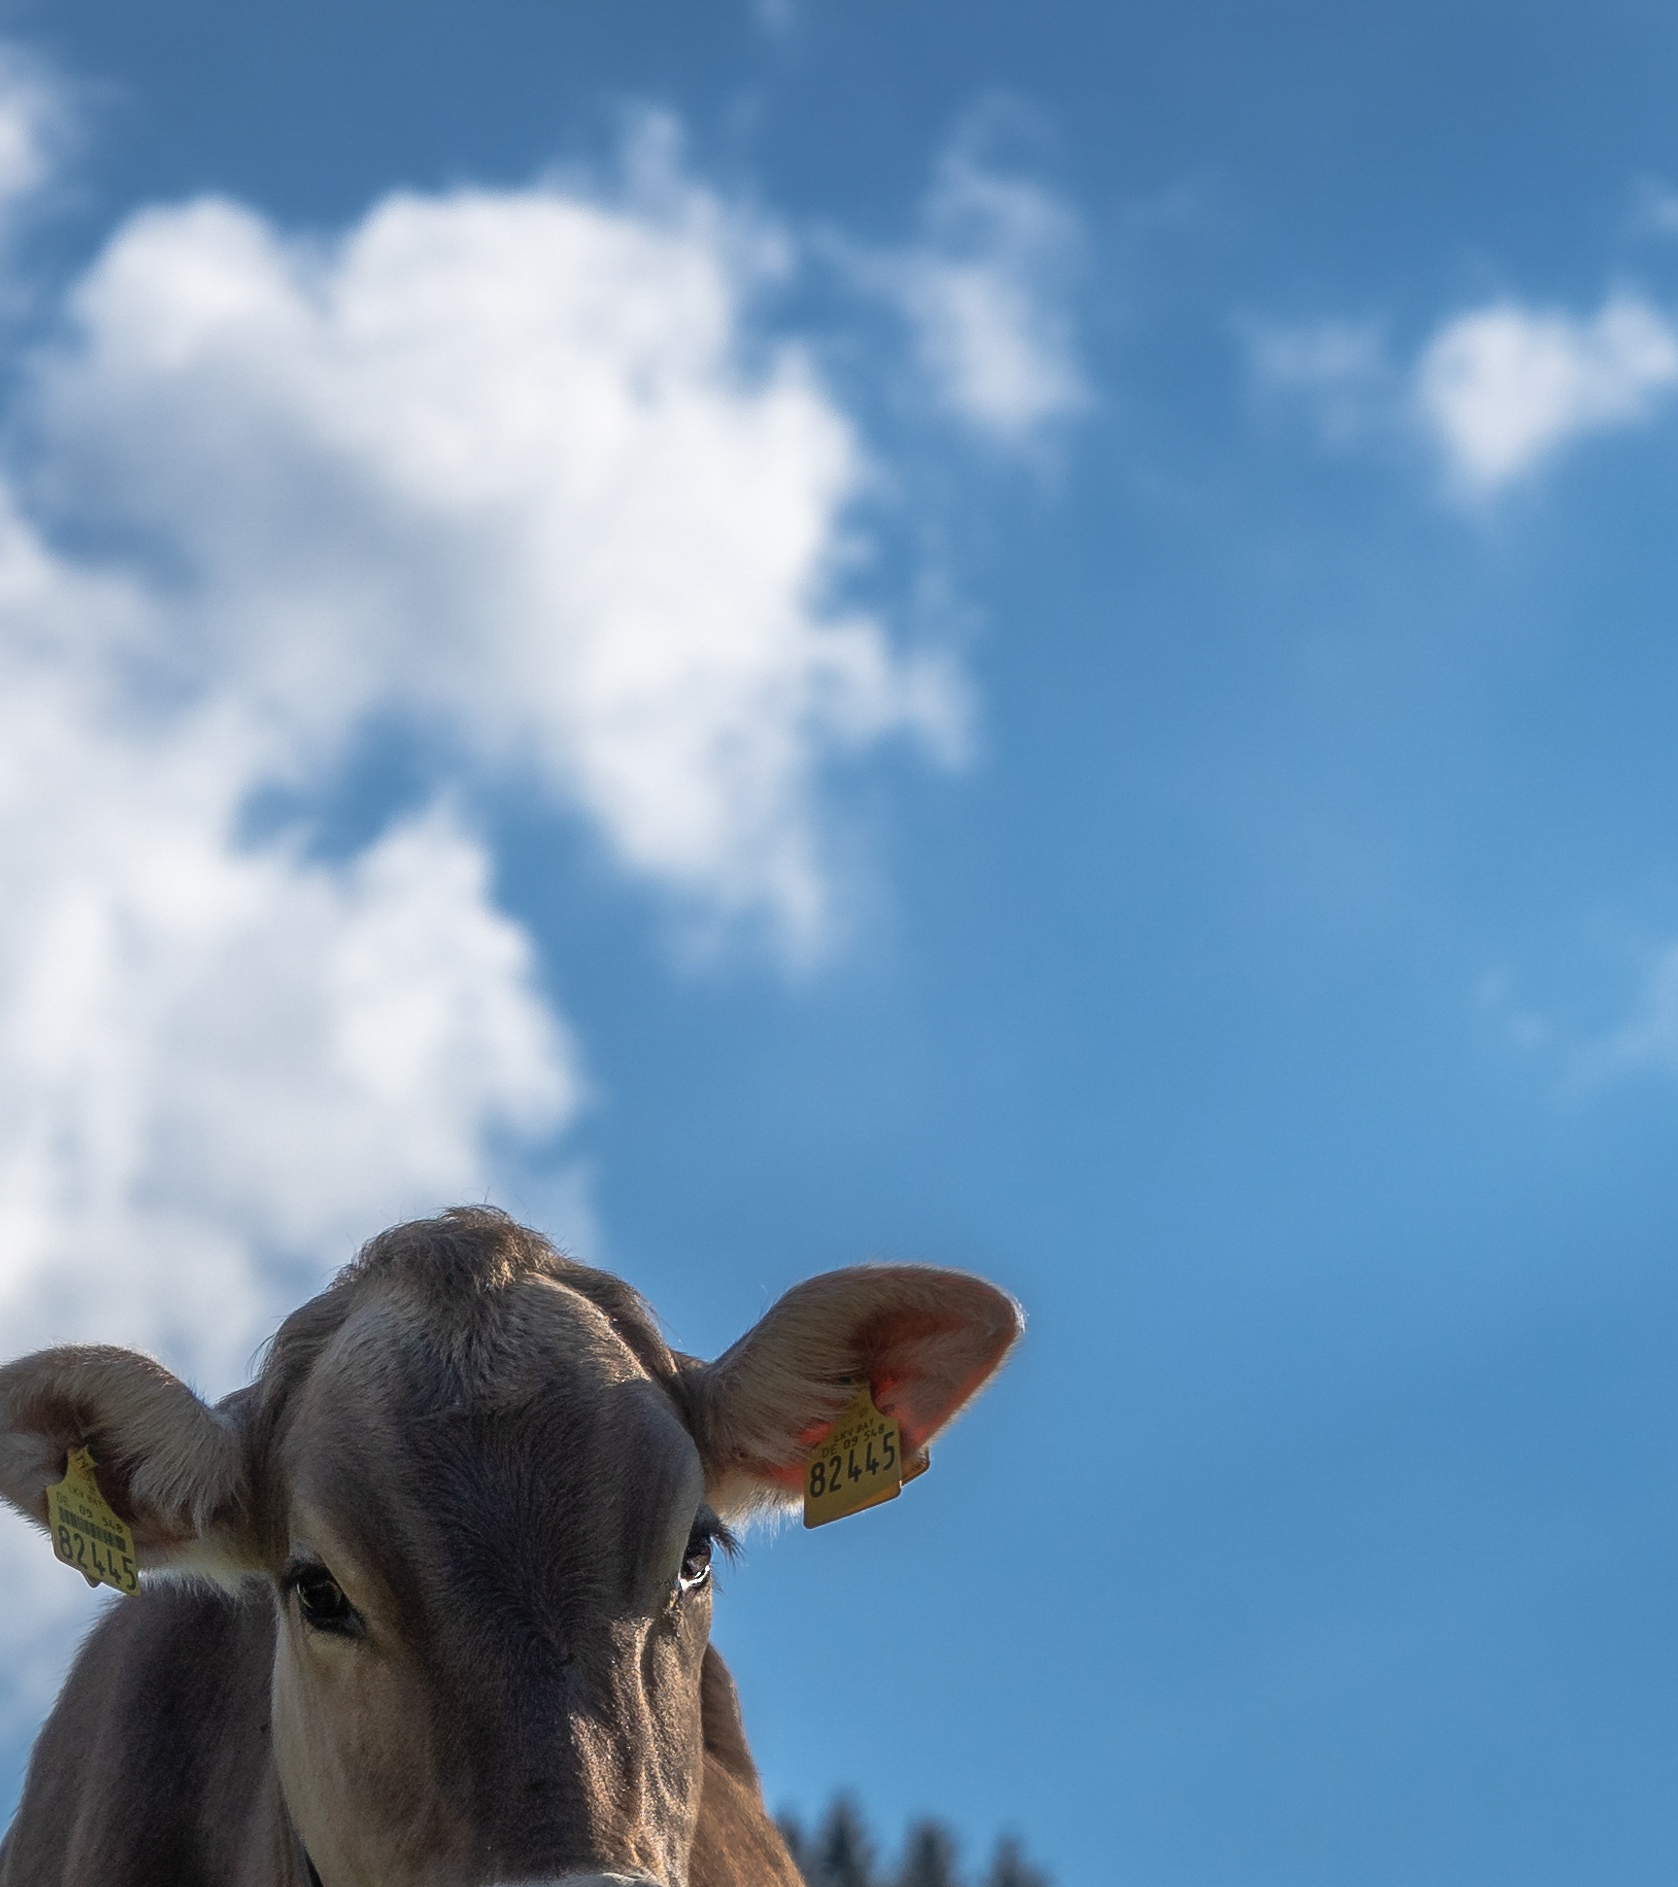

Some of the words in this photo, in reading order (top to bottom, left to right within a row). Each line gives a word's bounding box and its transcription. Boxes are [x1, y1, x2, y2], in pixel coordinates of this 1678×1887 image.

[809, 1431, 895, 1498] 82445
[822, 1443, 838, 1458] DE
[843, 1436, 859, 1450] 09
[58, 1525, 136, 1591] 82445
